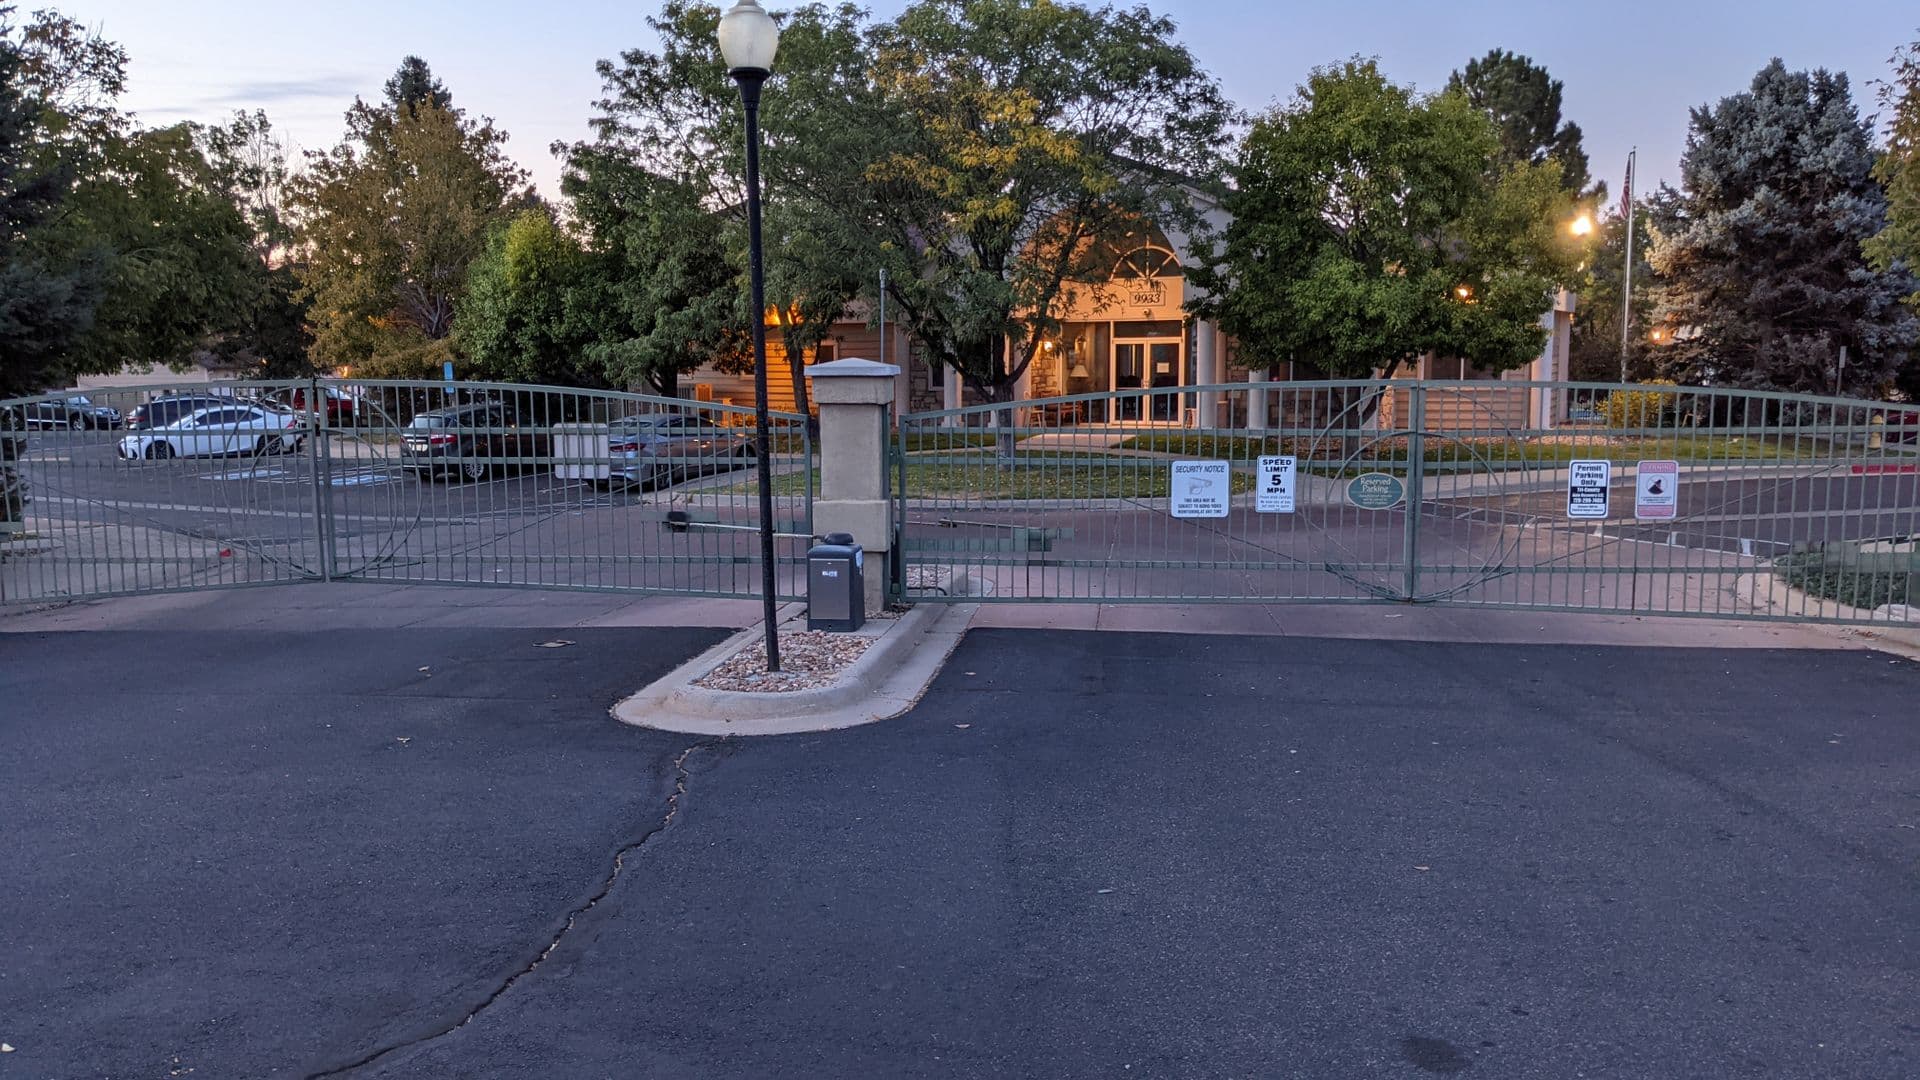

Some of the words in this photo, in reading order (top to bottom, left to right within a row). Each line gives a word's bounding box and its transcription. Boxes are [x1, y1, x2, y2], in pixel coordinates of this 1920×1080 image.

[1134, 293, 1160, 304] 9933
[1175, 465, 1203, 473] SECURITY
[1204, 465, 1225, 473] NOTICE
[1271, 474, 1282, 486] 5
[1360, 477, 1391, 486] Reserved
[1362, 485, 1389, 494] Parking
